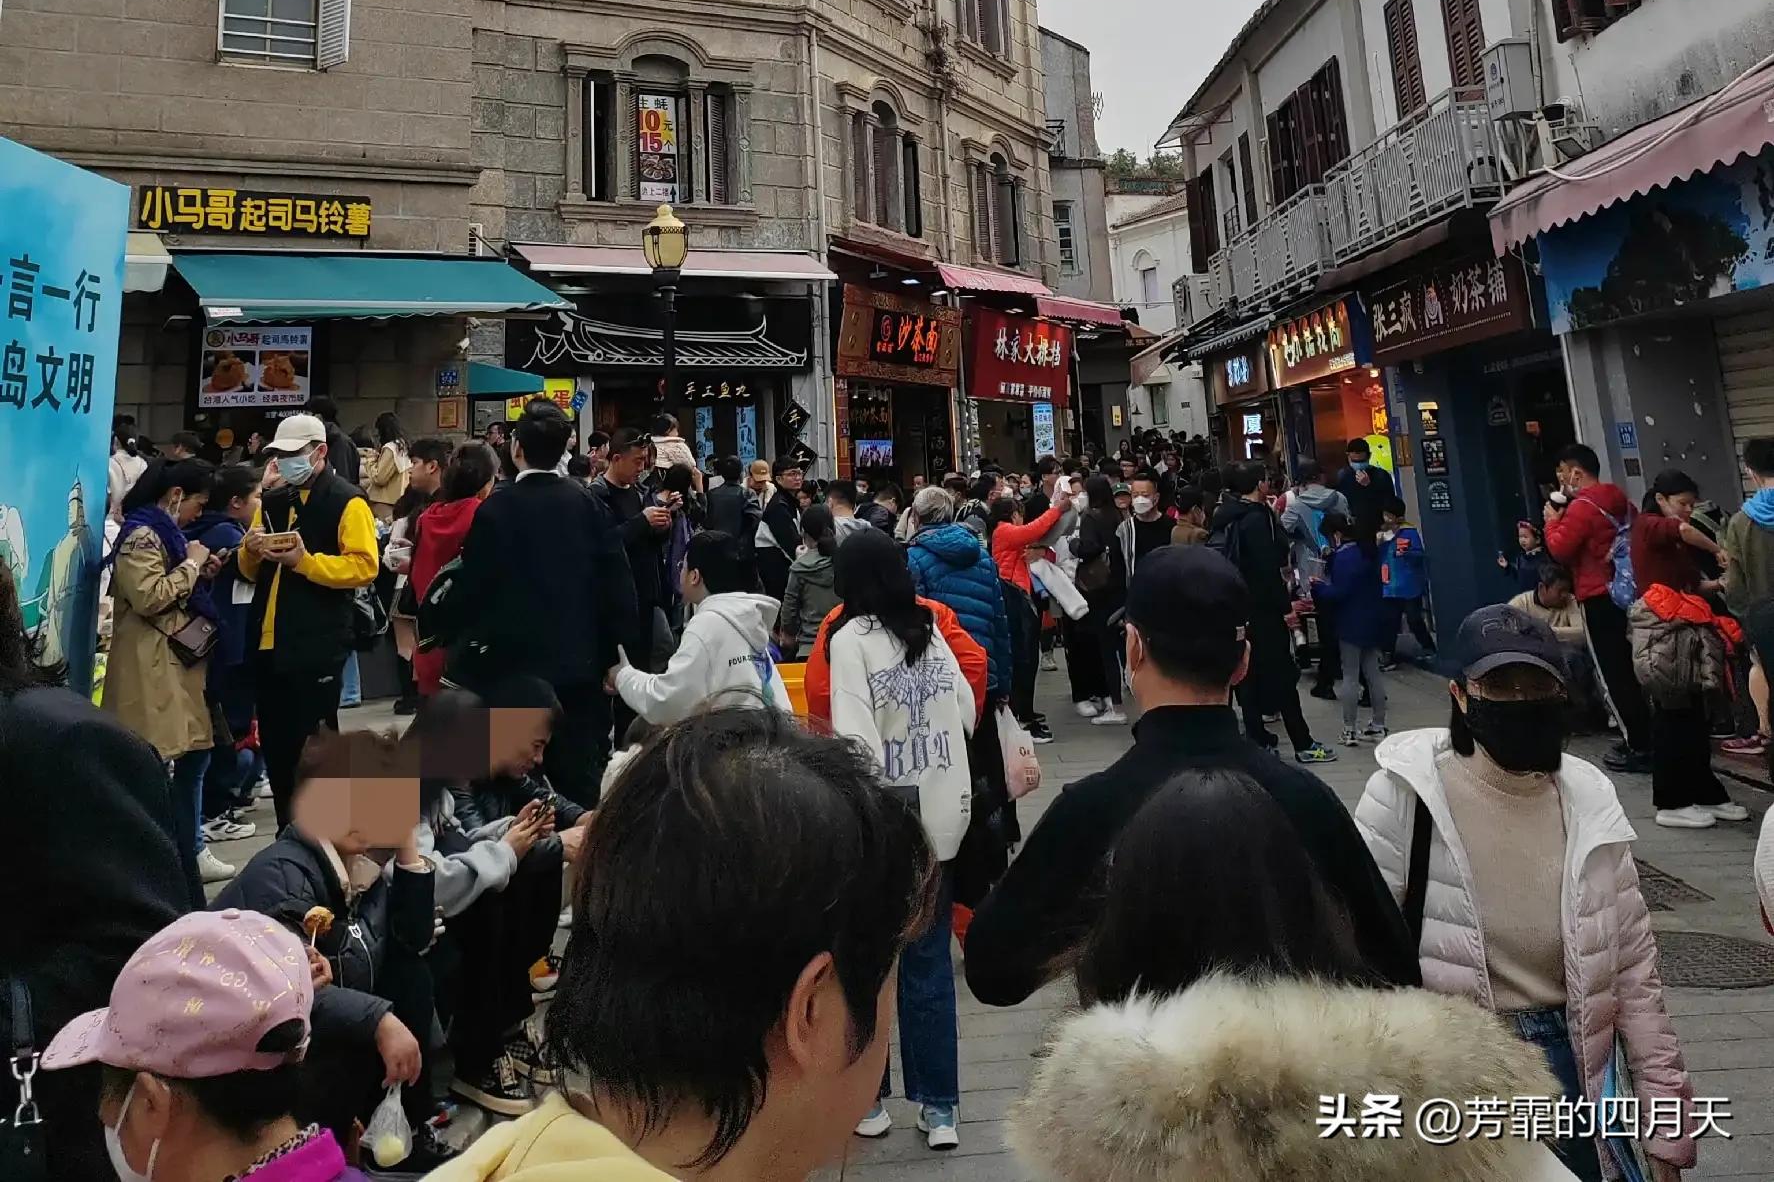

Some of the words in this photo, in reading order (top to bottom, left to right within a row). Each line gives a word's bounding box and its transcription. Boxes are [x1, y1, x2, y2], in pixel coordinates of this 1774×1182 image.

[141, 186, 237, 230] 小马哥
[239, 196, 372, 236] 起司马铃薯
[0, 253, 101, 333] 言一行
[1372, 290, 1417, 343] 张三疯
[1449, 258, 1508, 315] 奶茶铺
[897, 314, 938, 355] 沙茶面
[0, 339, 95, 415] 岛文明
